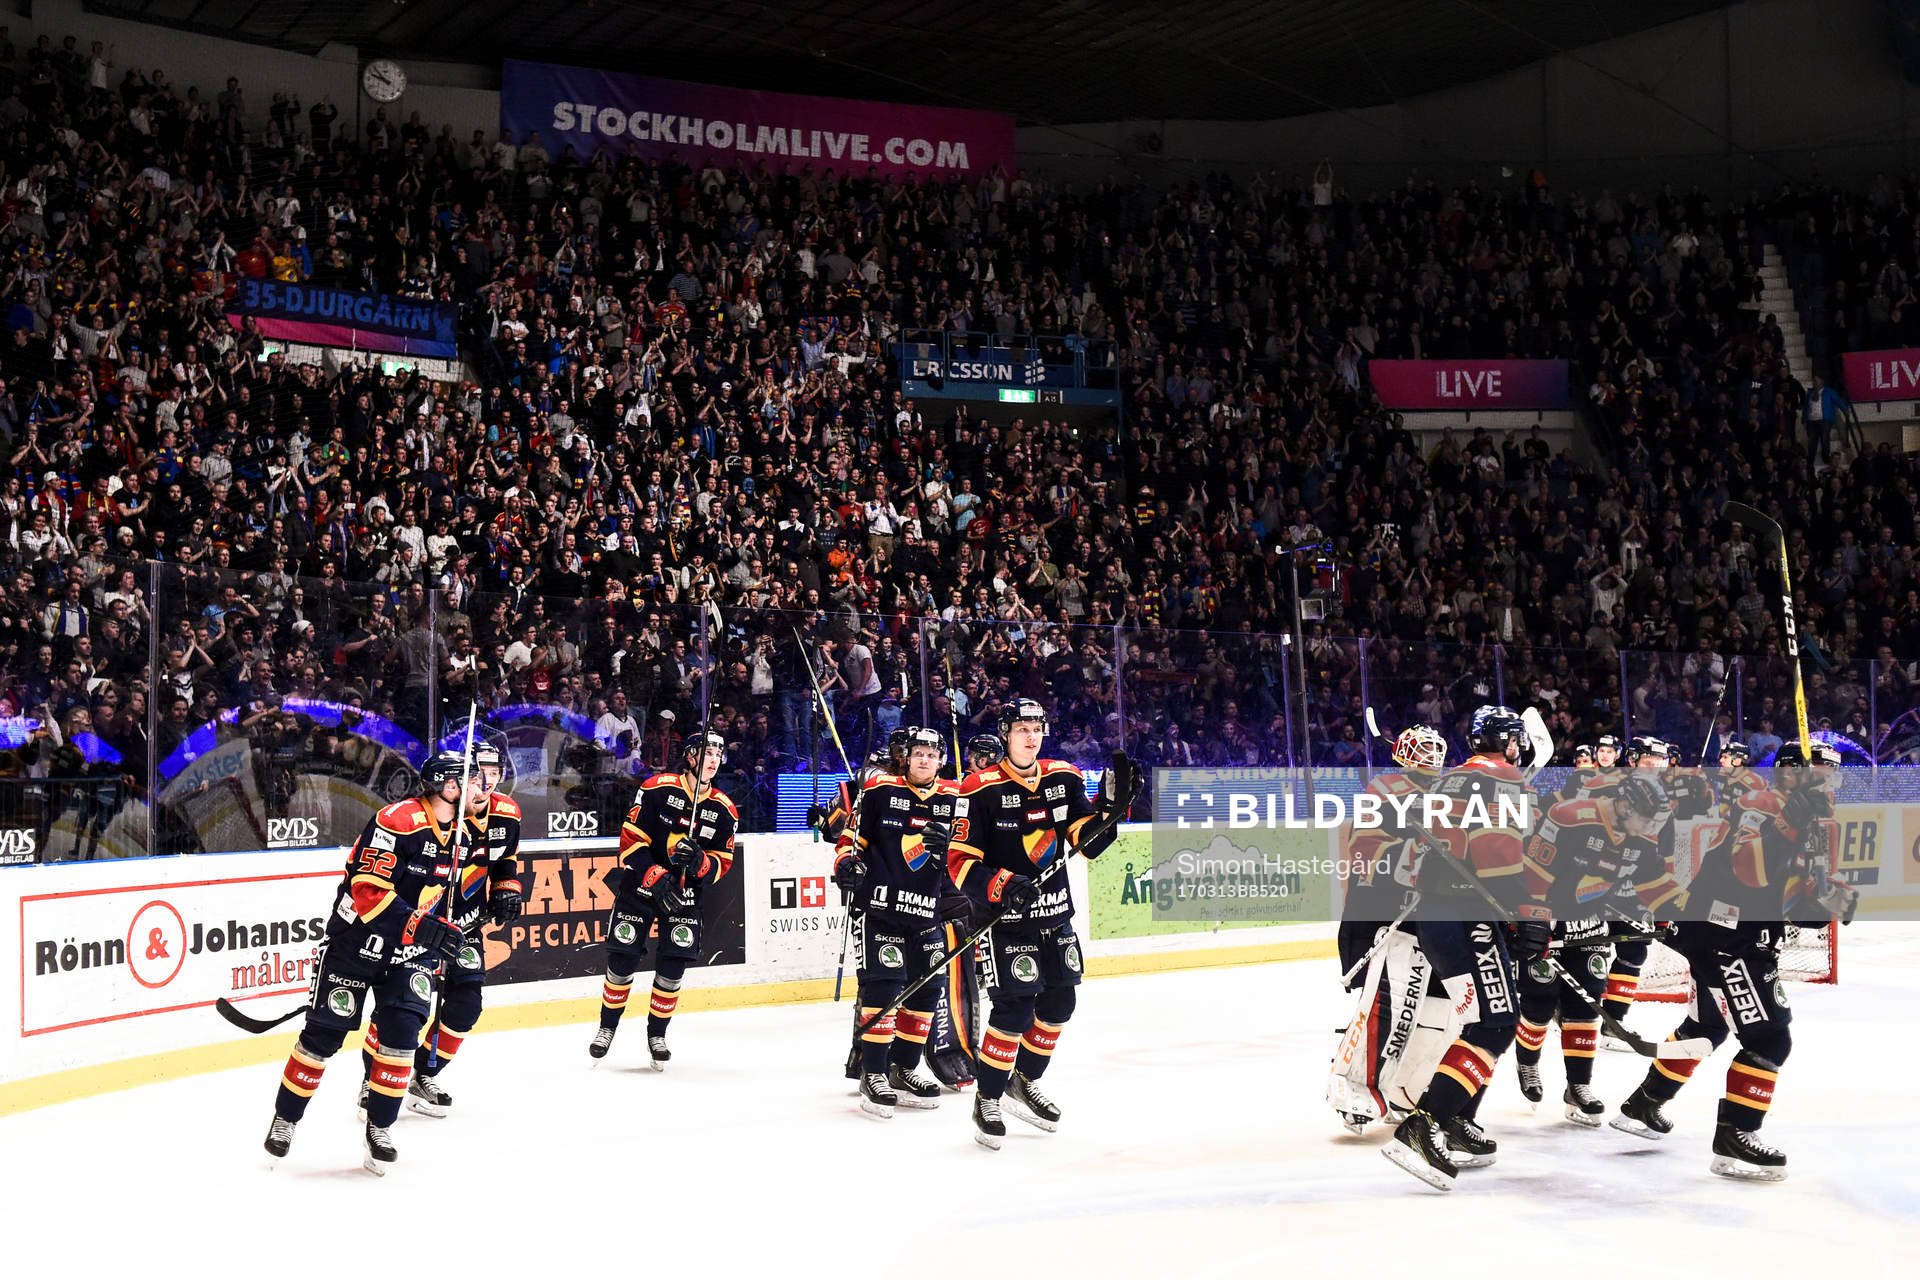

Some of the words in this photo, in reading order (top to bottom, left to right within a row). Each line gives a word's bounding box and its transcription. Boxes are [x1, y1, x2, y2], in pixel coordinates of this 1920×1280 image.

[553, 101, 970, 169] STOCKHOLMLIVE.COM
[1440, 370, 1502, 397] LIVE
[1875, 360, 1920, 388] LIV
[1782, 595, 1798, 657] CCM
[268, 817, 319, 841] RYDS
[548, 811, 598, 832] RYDS
[0, 829, 36, 855] YDS
[1528, 835, 1557, 866] 80
[1838, 821, 1877, 862] ER
[357, 847, 397, 879] 52
[617, 911, 644, 924] ŠKODA
[770, 917, 819, 933] SWISS
[35, 937, 125, 976] Rönn
[145, 927, 171, 961] &
[189, 917, 327, 955] Johanss
[874, 933, 905, 945] ŠKODA
[923, 940, 945, 951] ŠKOD
[1005, 943, 1039, 954] ŠKODA
[328, 973, 367, 990] ŠKODA
[1477, 951, 1508, 1014] REFIX
[1720, 959, 1763, 1025] REFIX
[1386, 965, 1425, 1059] SMEDERNA
[1034, 1034, 1057, 1045] Stav
[1343, 1011, 1367, 1065] CCM
[1575, 1037, 1597, 1045] Stav
[296, 1071, 321, 1085] Stav
[1748, 1086, 1774, 1098] Stav
